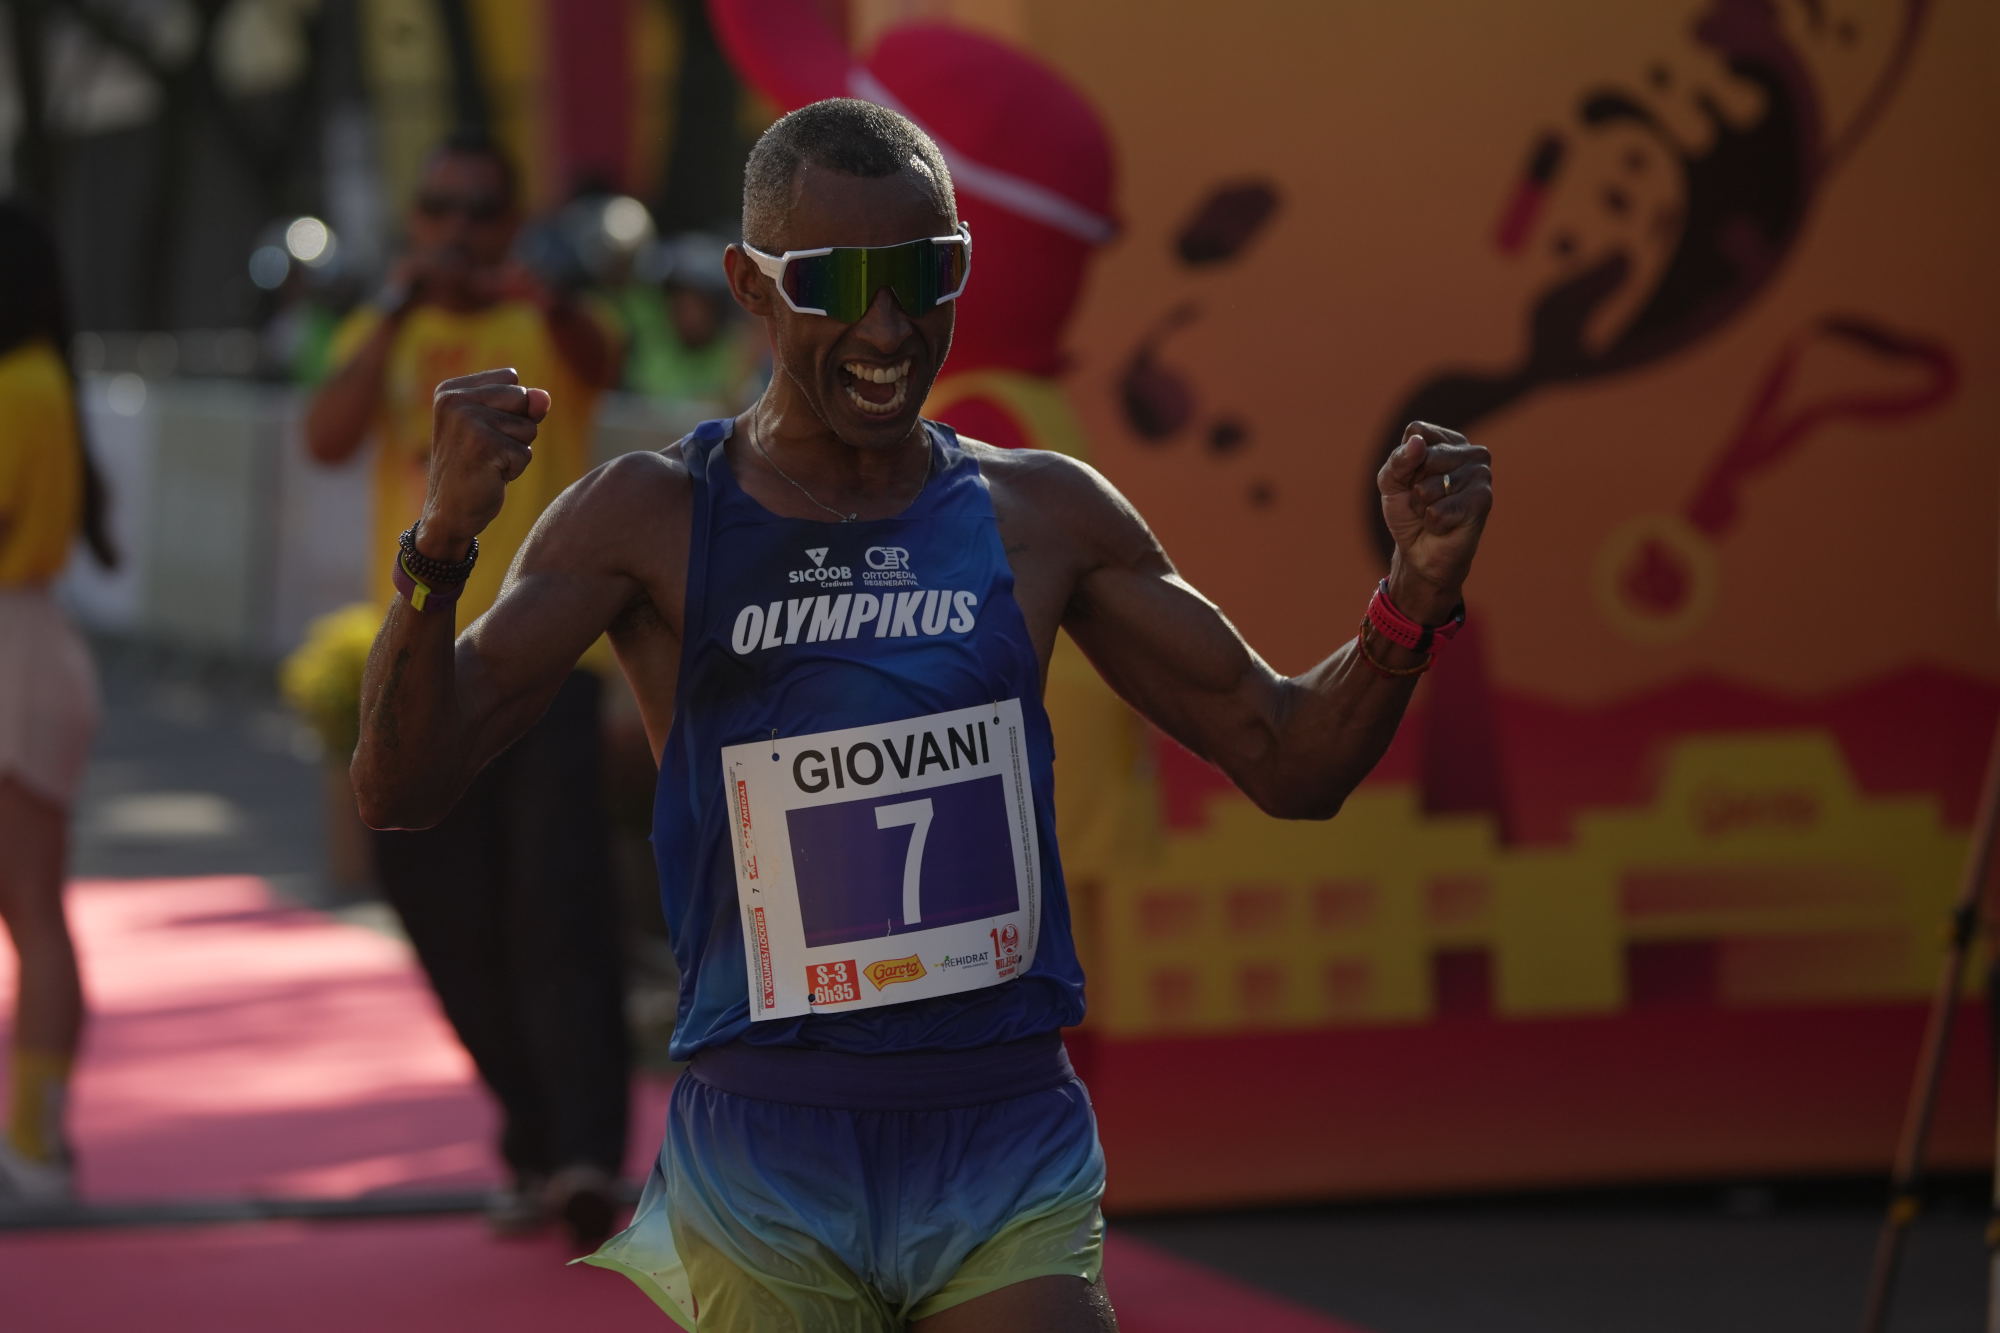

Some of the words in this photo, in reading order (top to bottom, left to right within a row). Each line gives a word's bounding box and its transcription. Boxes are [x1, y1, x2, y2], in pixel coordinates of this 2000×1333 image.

[788, 566, 852, 583] SICOOB
[862, 571, 917, 580] ORTOPEDIA
[731, 590, 977, 655] OLYMPIKUS
[792, 721, 990, 793] GIOVANI
[874, 797, 934, 925] 7
[944, 952, 989, 969] REHIDRAT
[817, 963, 848, 985] S-3
[815, 983, 854, 1005] 6h35
